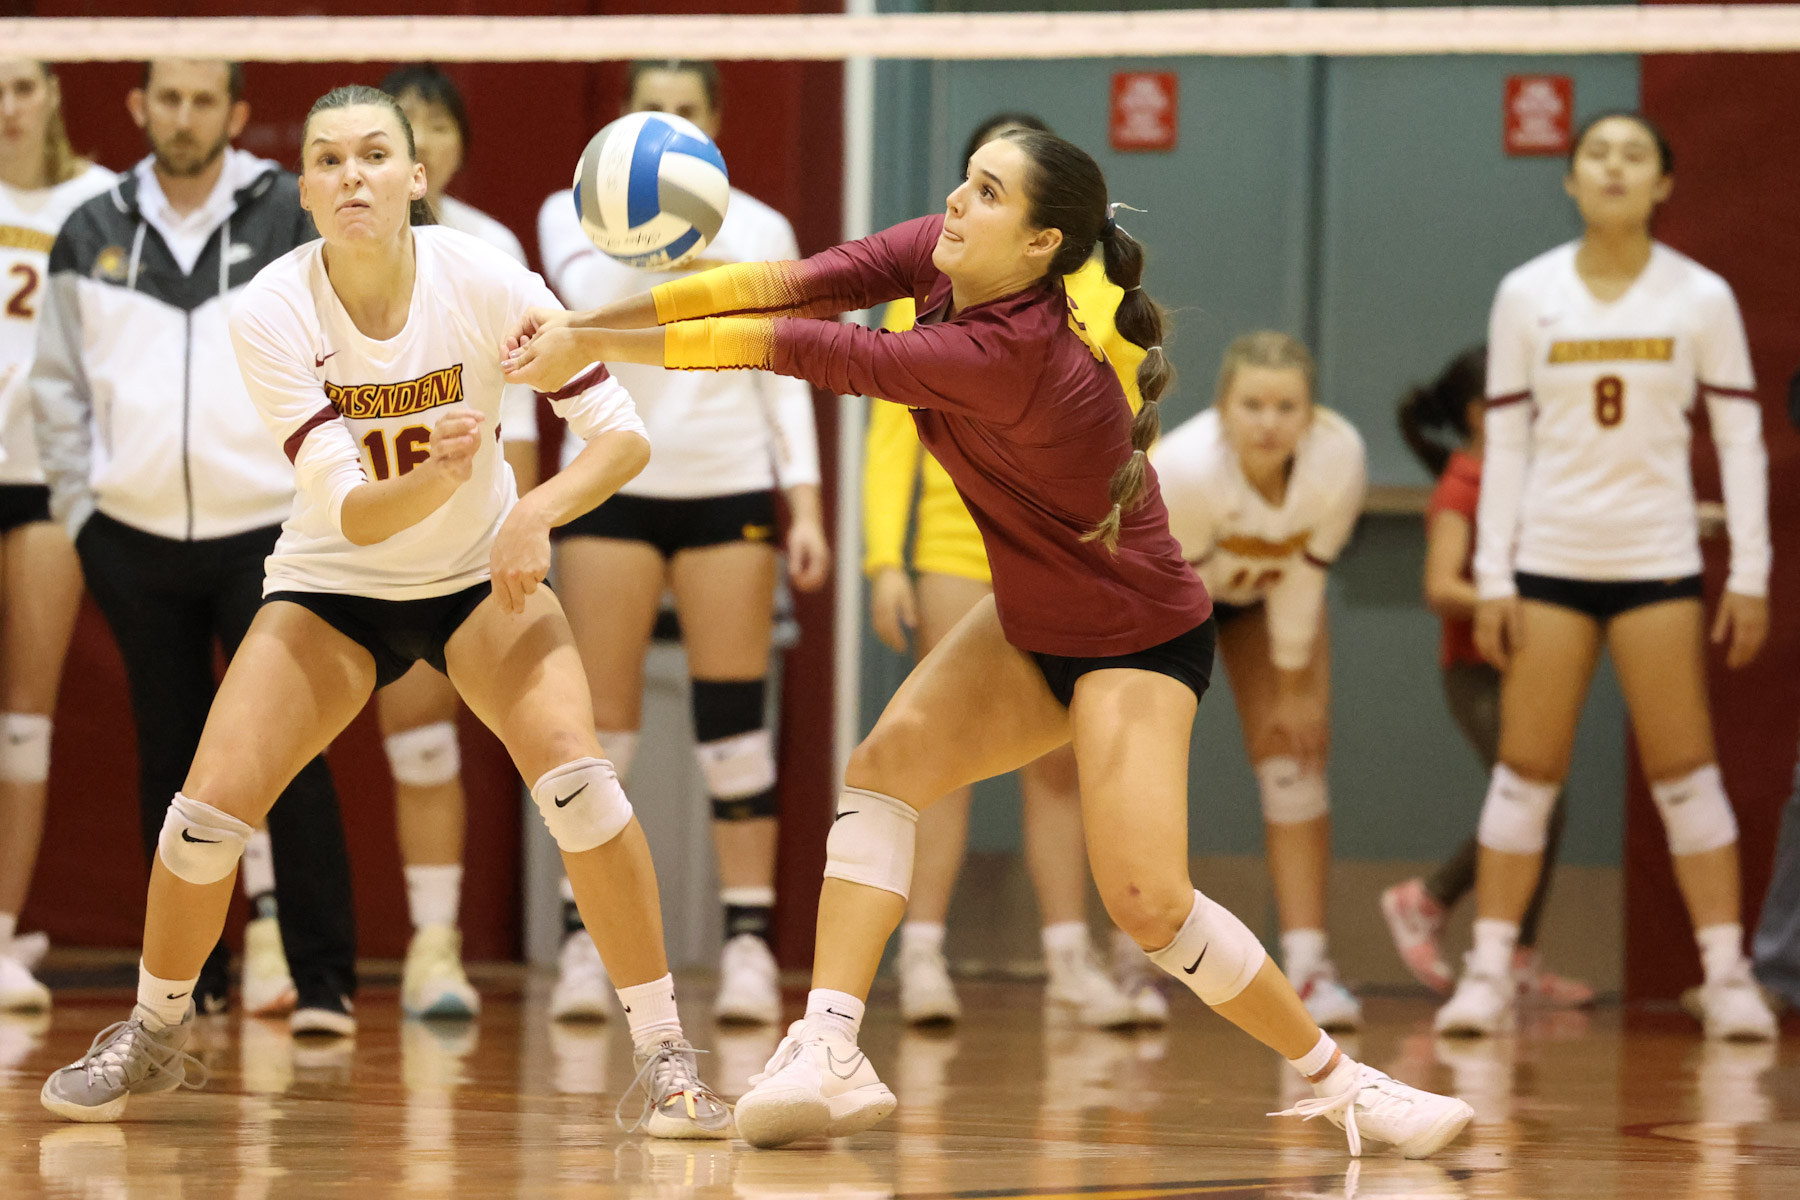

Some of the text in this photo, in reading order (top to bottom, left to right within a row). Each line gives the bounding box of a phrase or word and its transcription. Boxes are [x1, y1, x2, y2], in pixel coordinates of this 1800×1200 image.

[6, 263, 38, 318] 2
[324, 363, 463, 419] PASADENA
[1594, 375, 1625, 428] 8
